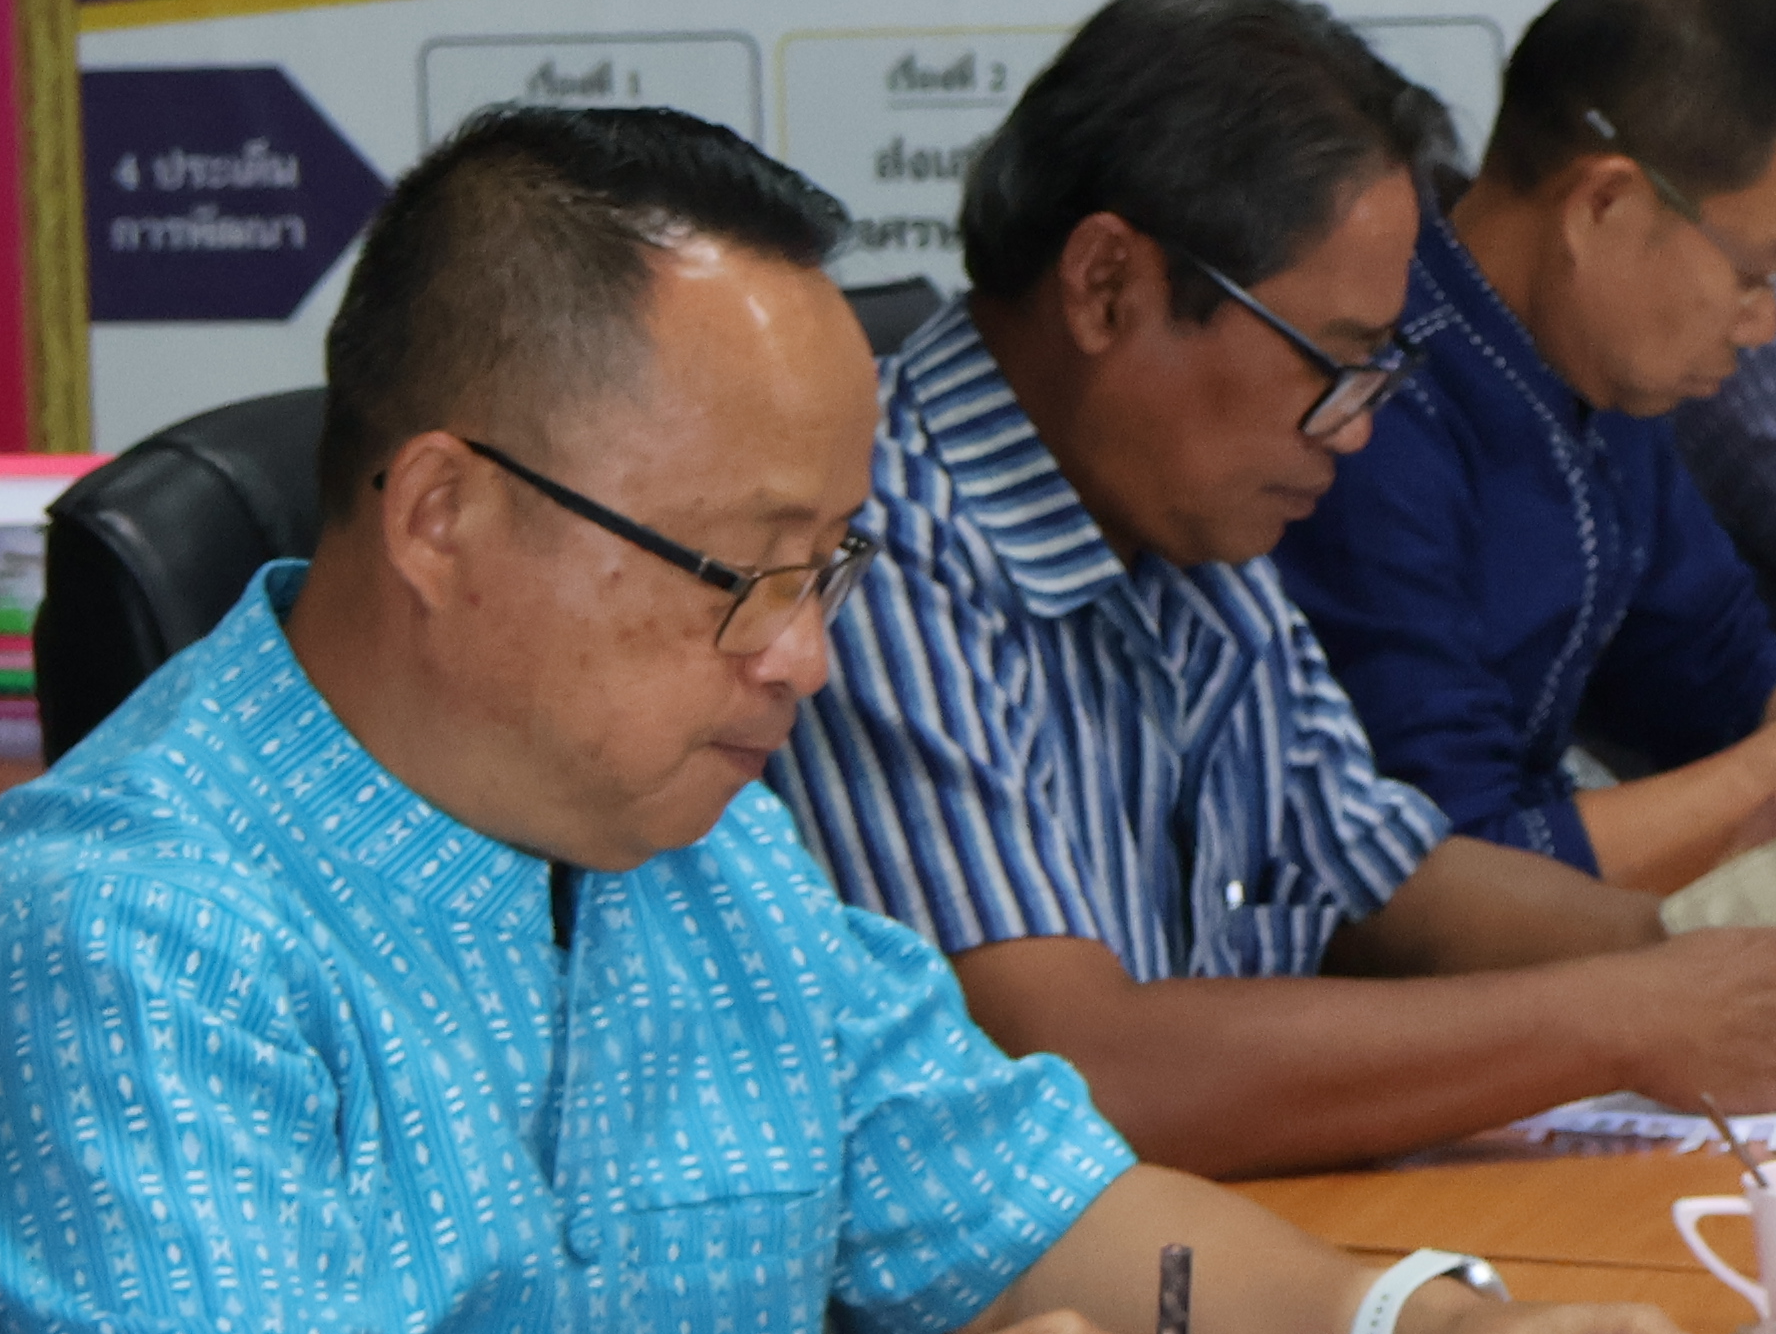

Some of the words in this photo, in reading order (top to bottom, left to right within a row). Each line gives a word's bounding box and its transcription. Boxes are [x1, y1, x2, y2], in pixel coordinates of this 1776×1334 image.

[113, 151, 141, 192] 4
[109, 202, 308, 253] การพัฒนา
